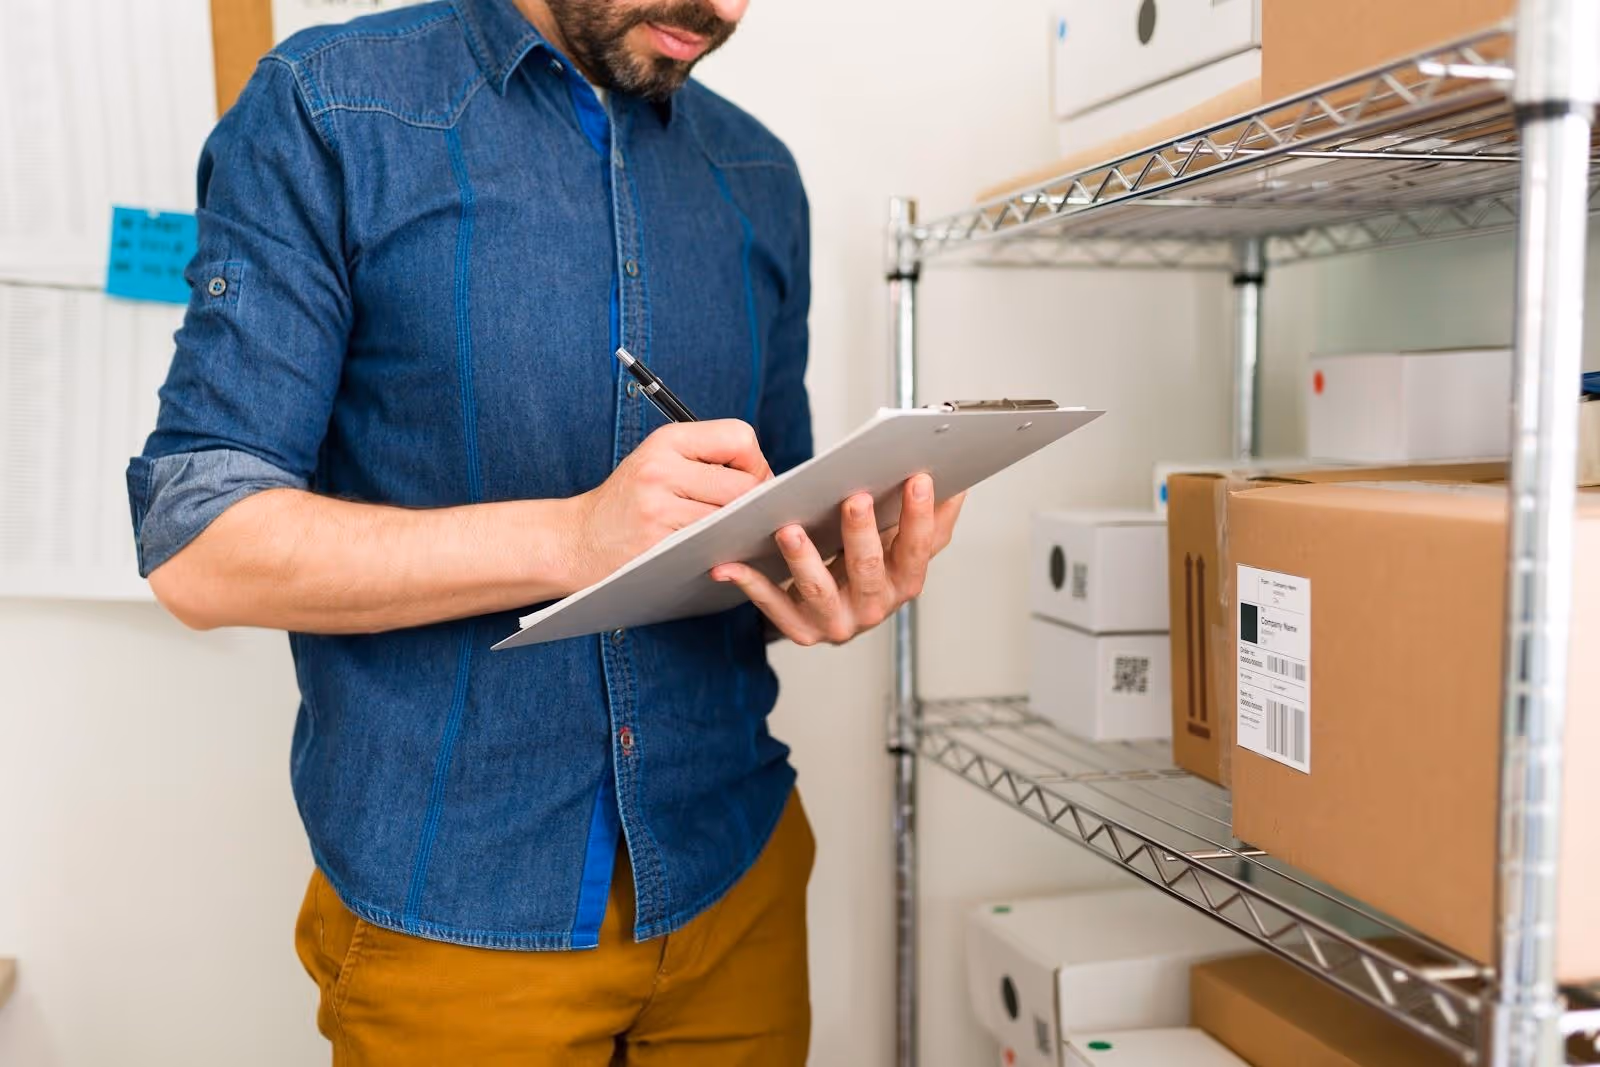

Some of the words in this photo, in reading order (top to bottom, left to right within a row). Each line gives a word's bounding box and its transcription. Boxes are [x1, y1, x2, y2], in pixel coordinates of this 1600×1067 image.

[1261, 616, 1282, 632] Company
[1283, 622, 1297, 633] Name
[1240, 646, 1250, 655] Order
